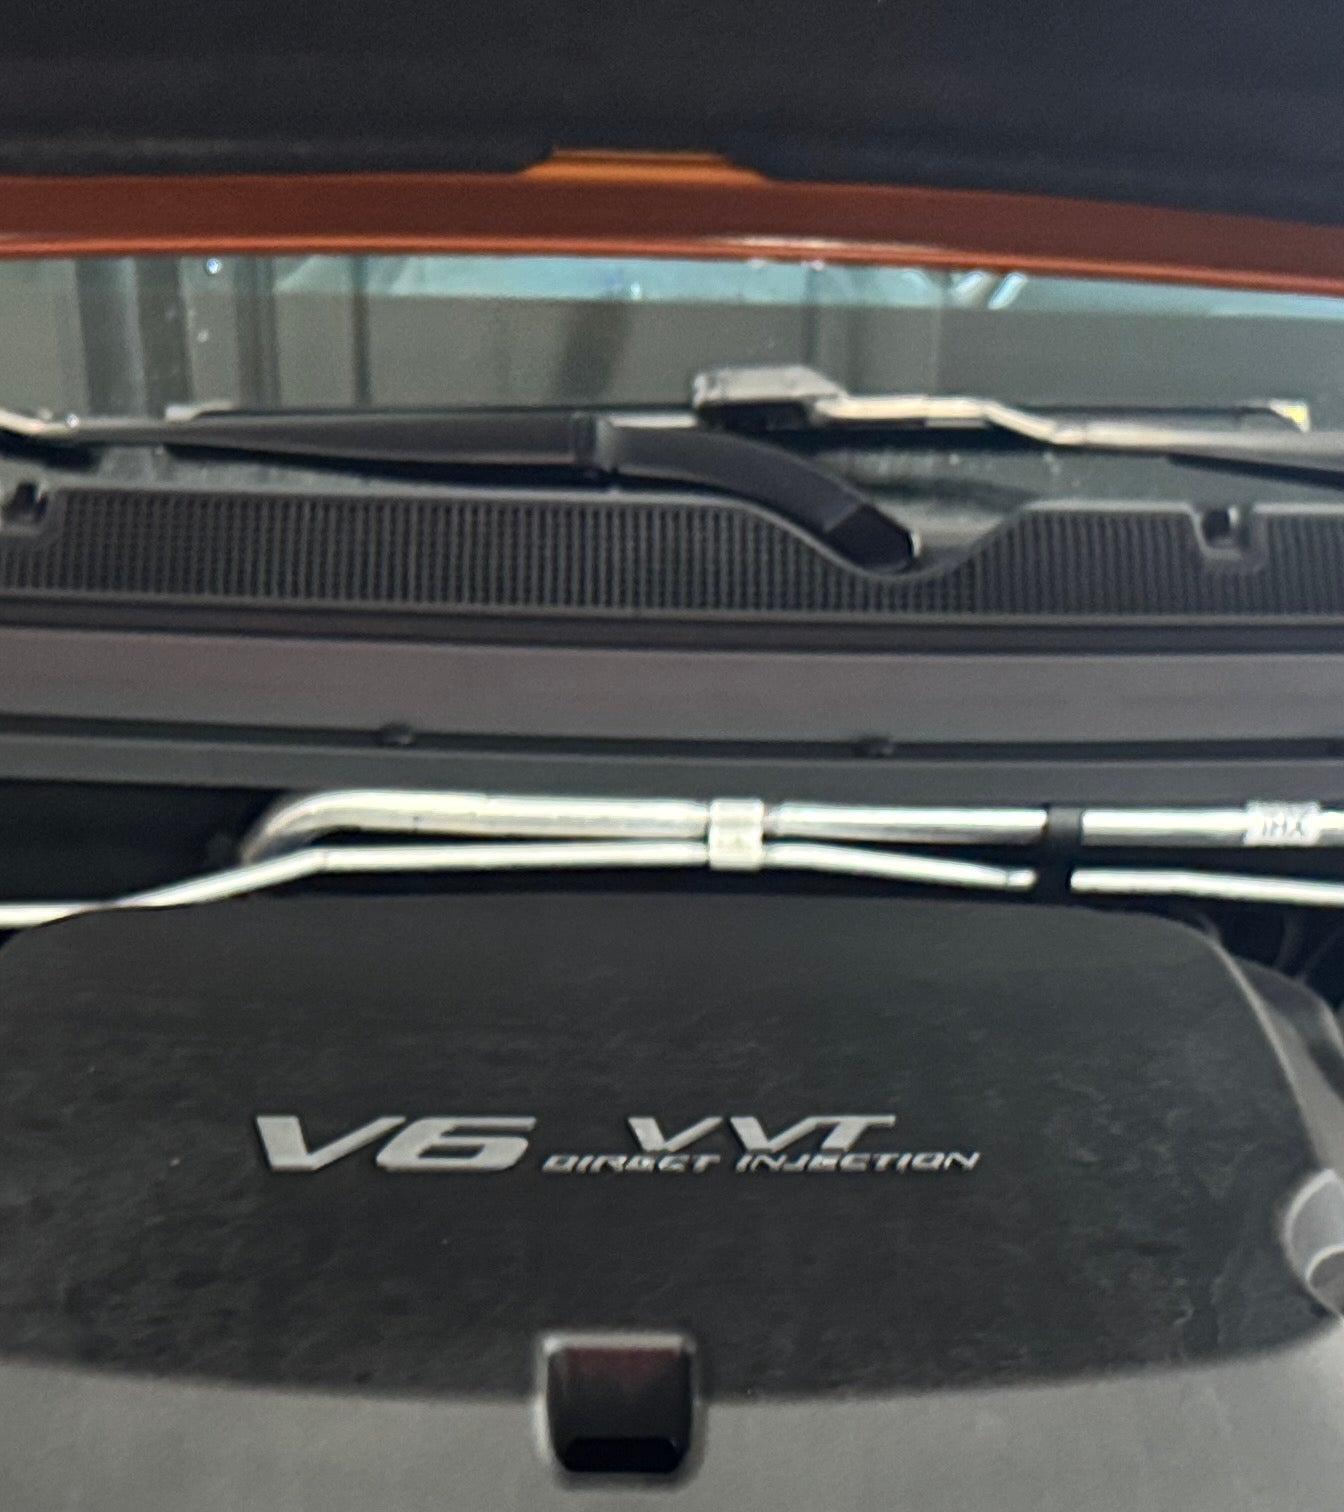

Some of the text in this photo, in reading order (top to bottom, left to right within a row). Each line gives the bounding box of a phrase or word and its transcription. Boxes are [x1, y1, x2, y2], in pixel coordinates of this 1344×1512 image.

[256, 1116, 536, 1172] V6
[627, 1114, 896, 1154] VVT
[542, 1151, 981, 1174] DIRECT INJECTION
